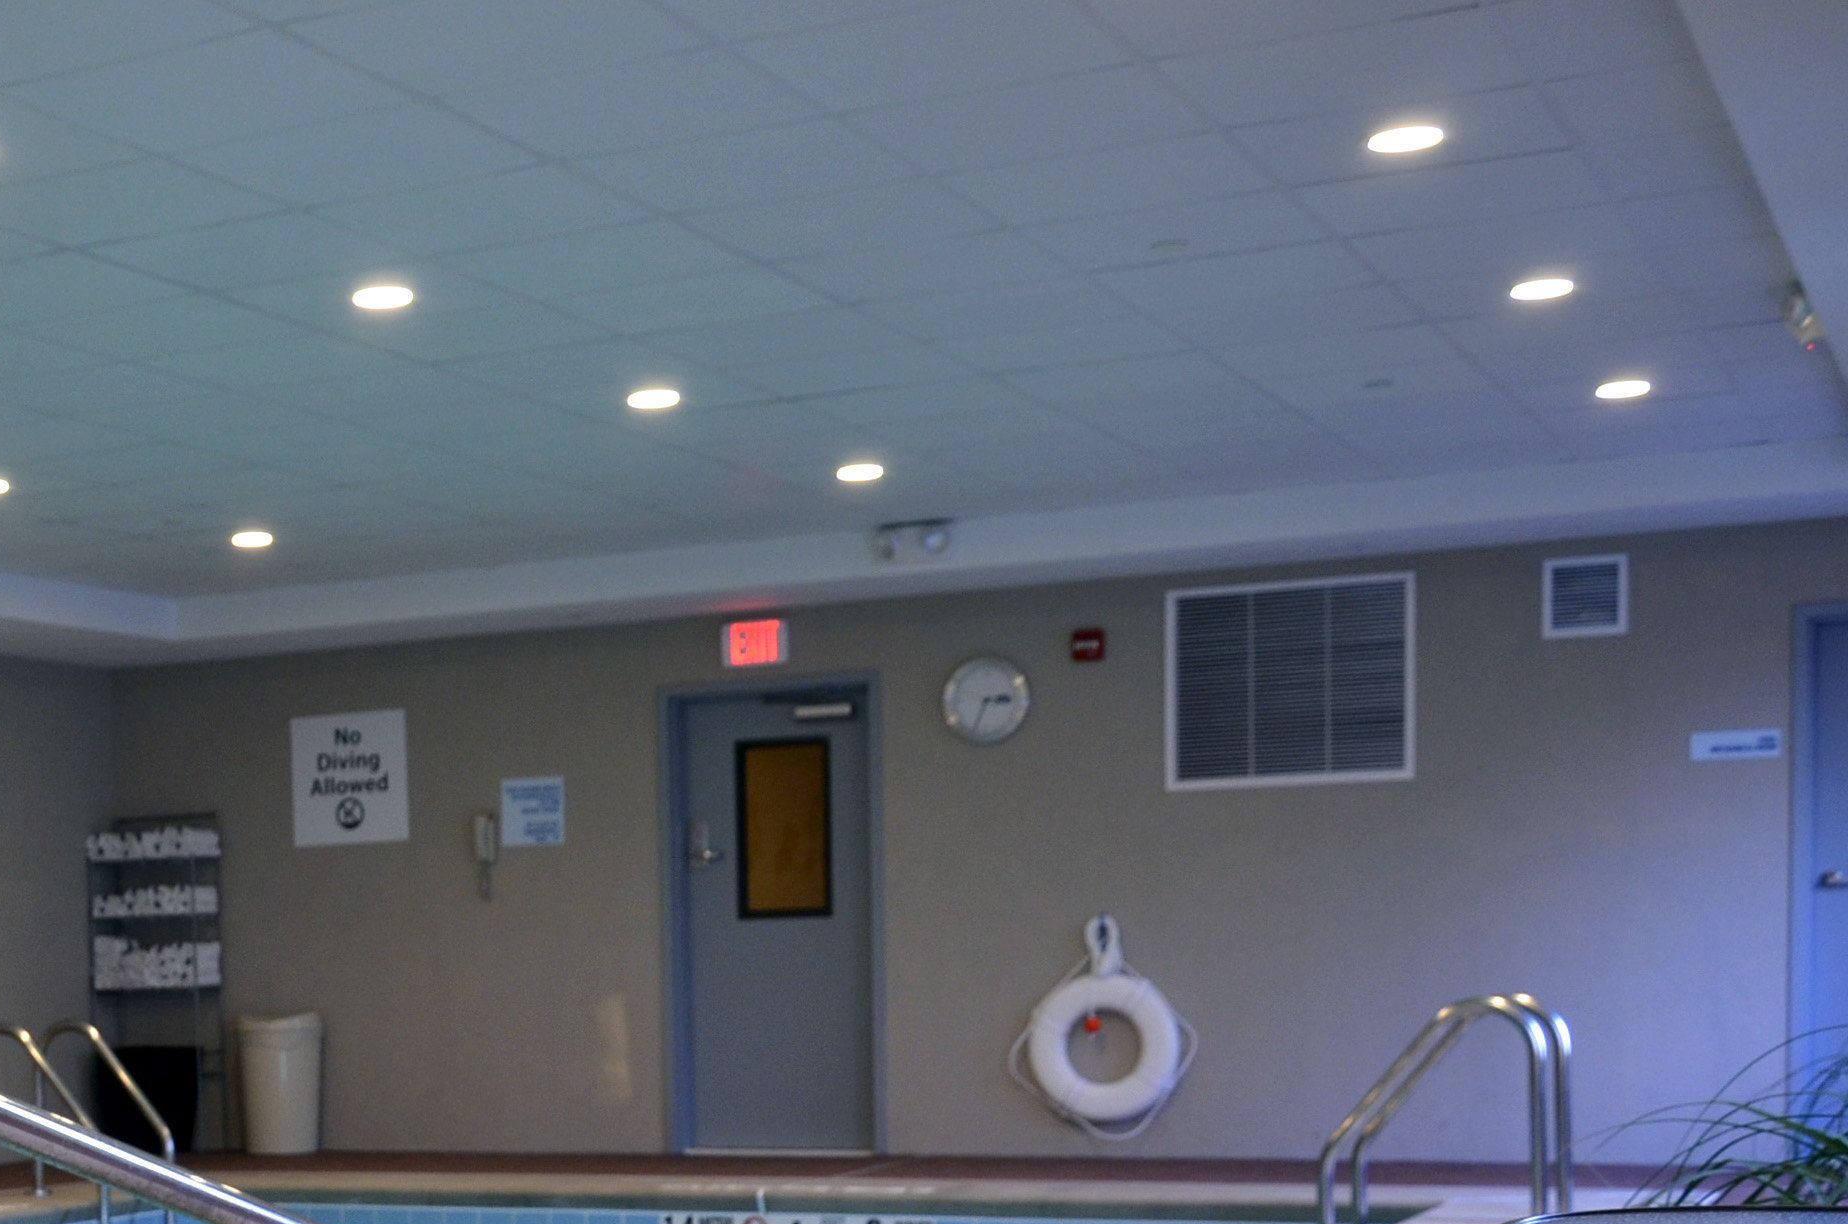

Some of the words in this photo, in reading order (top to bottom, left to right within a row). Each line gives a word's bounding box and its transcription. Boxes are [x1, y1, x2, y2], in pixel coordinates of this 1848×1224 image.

[334, 727, 362, 745] No
[316, 752, 381, 772] Diving
[310, 773, 389, 797] Allowed
